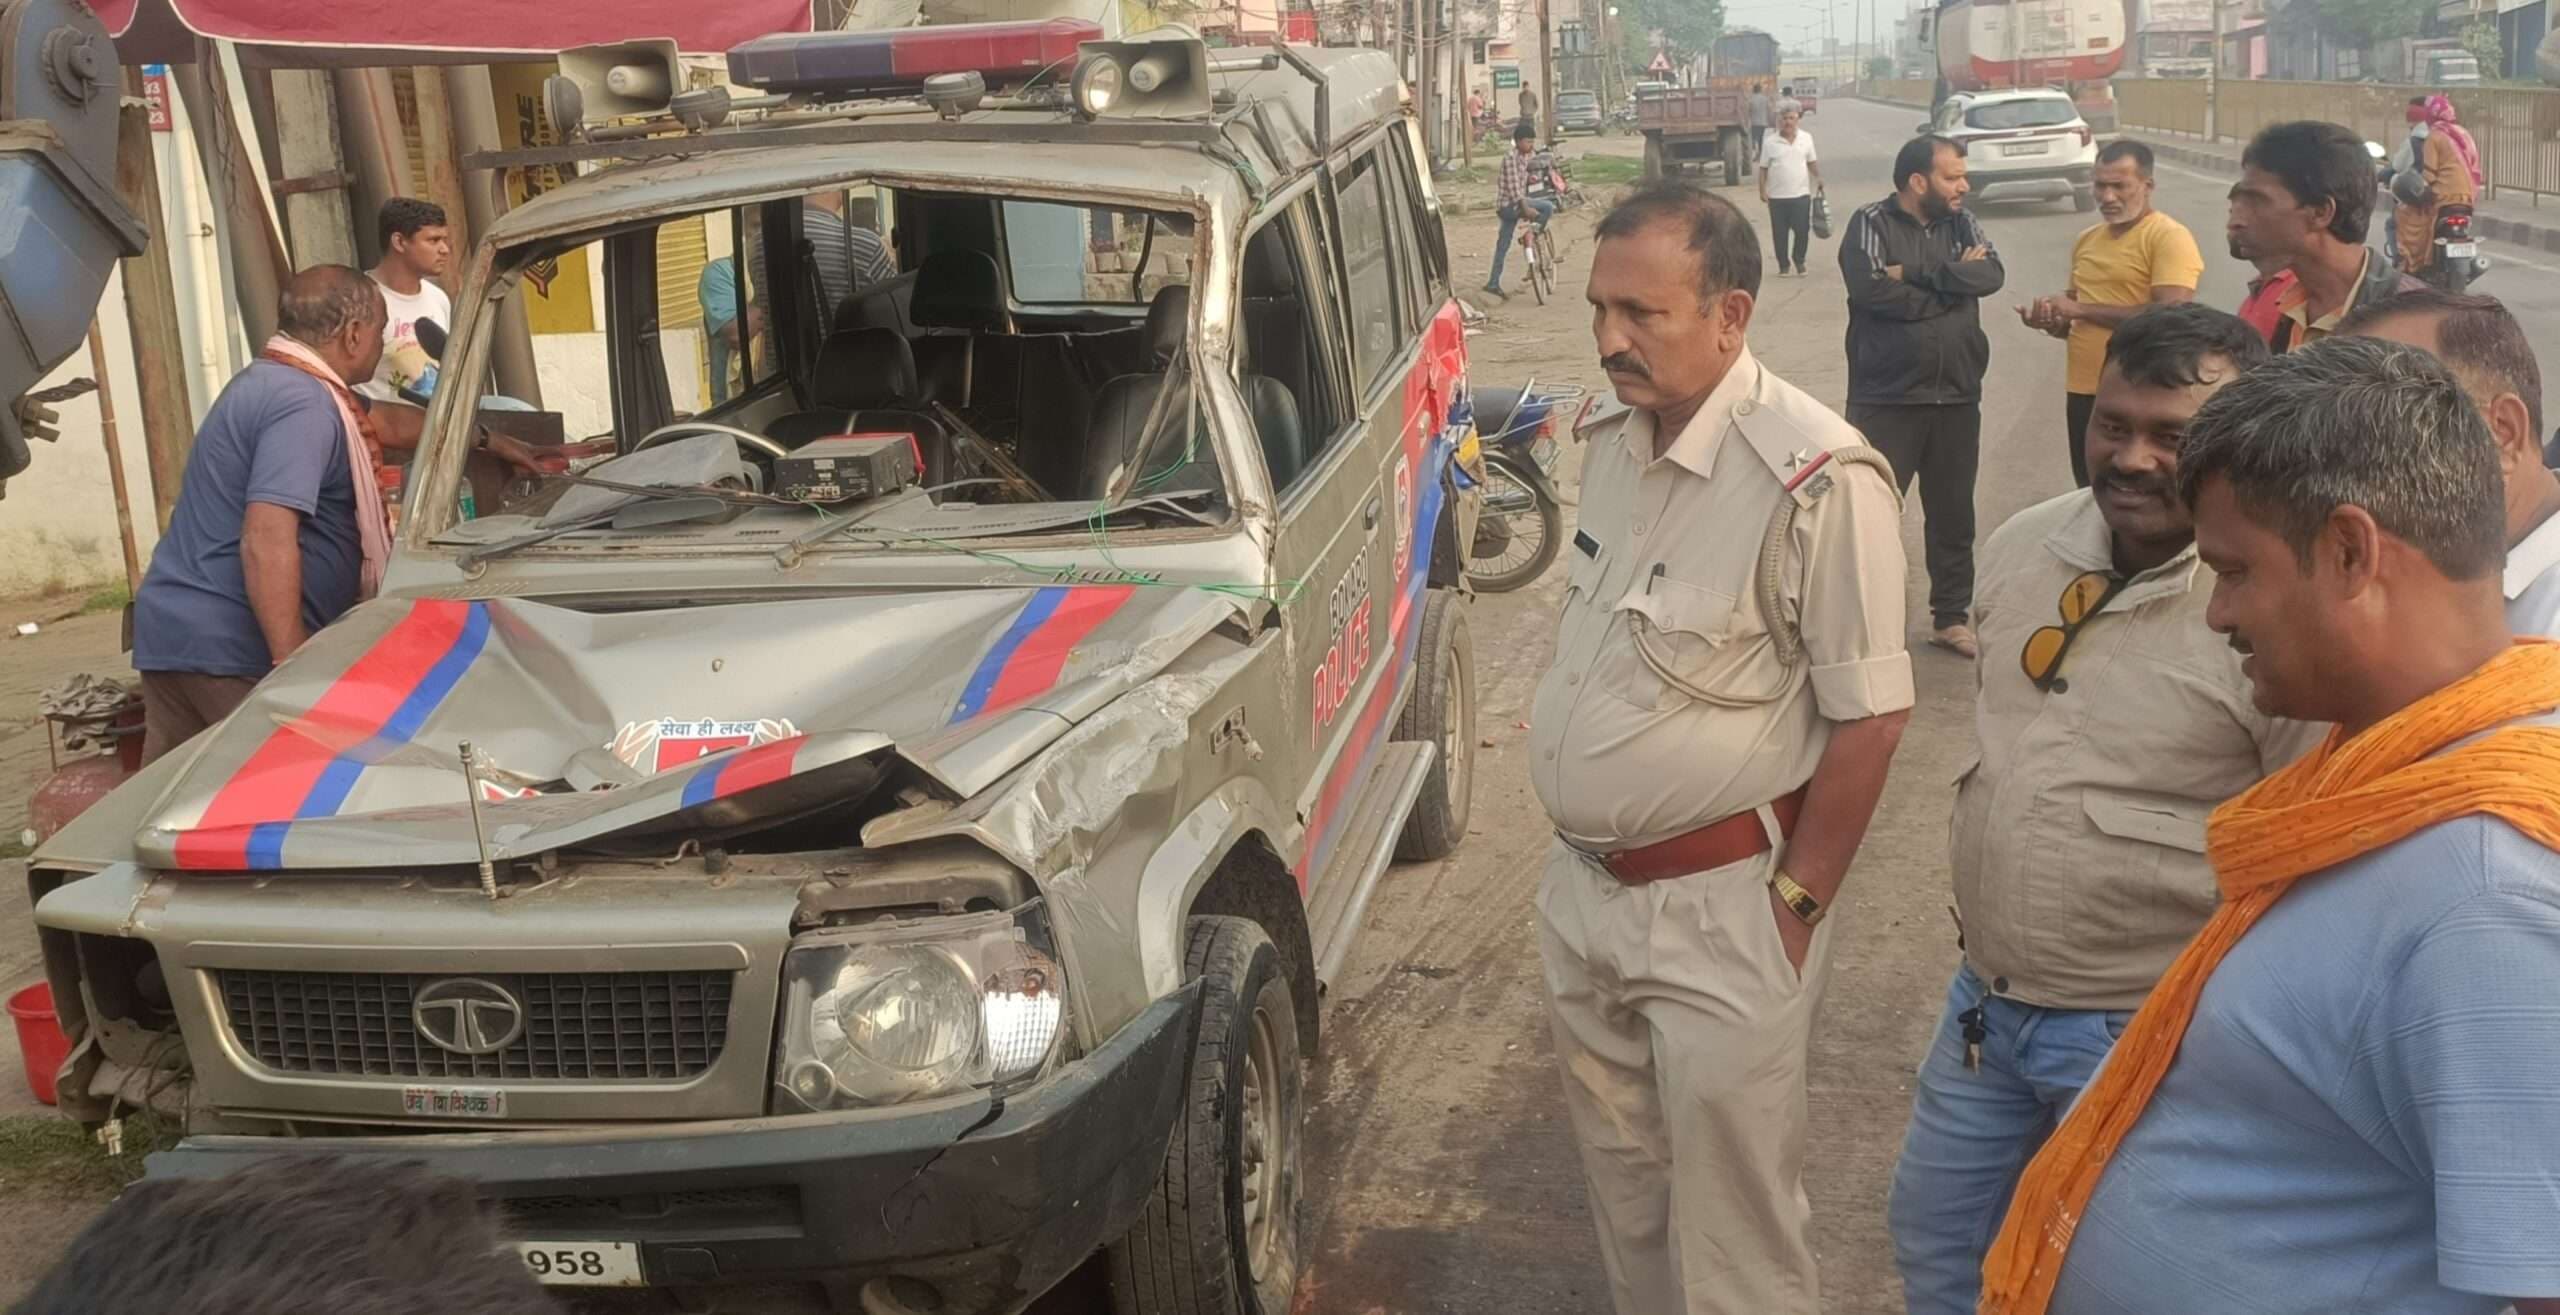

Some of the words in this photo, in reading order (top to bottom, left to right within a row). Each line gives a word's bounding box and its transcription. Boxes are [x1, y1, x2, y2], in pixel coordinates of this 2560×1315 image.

[1312, 591, 1371, 752] POLICE
[661, 719, 691, 736] सेवा
[698, 718, 714, 736] ही
[720, 722, 756, 735] लक्ष्य
[527, 1250, 605, 1276] 958
